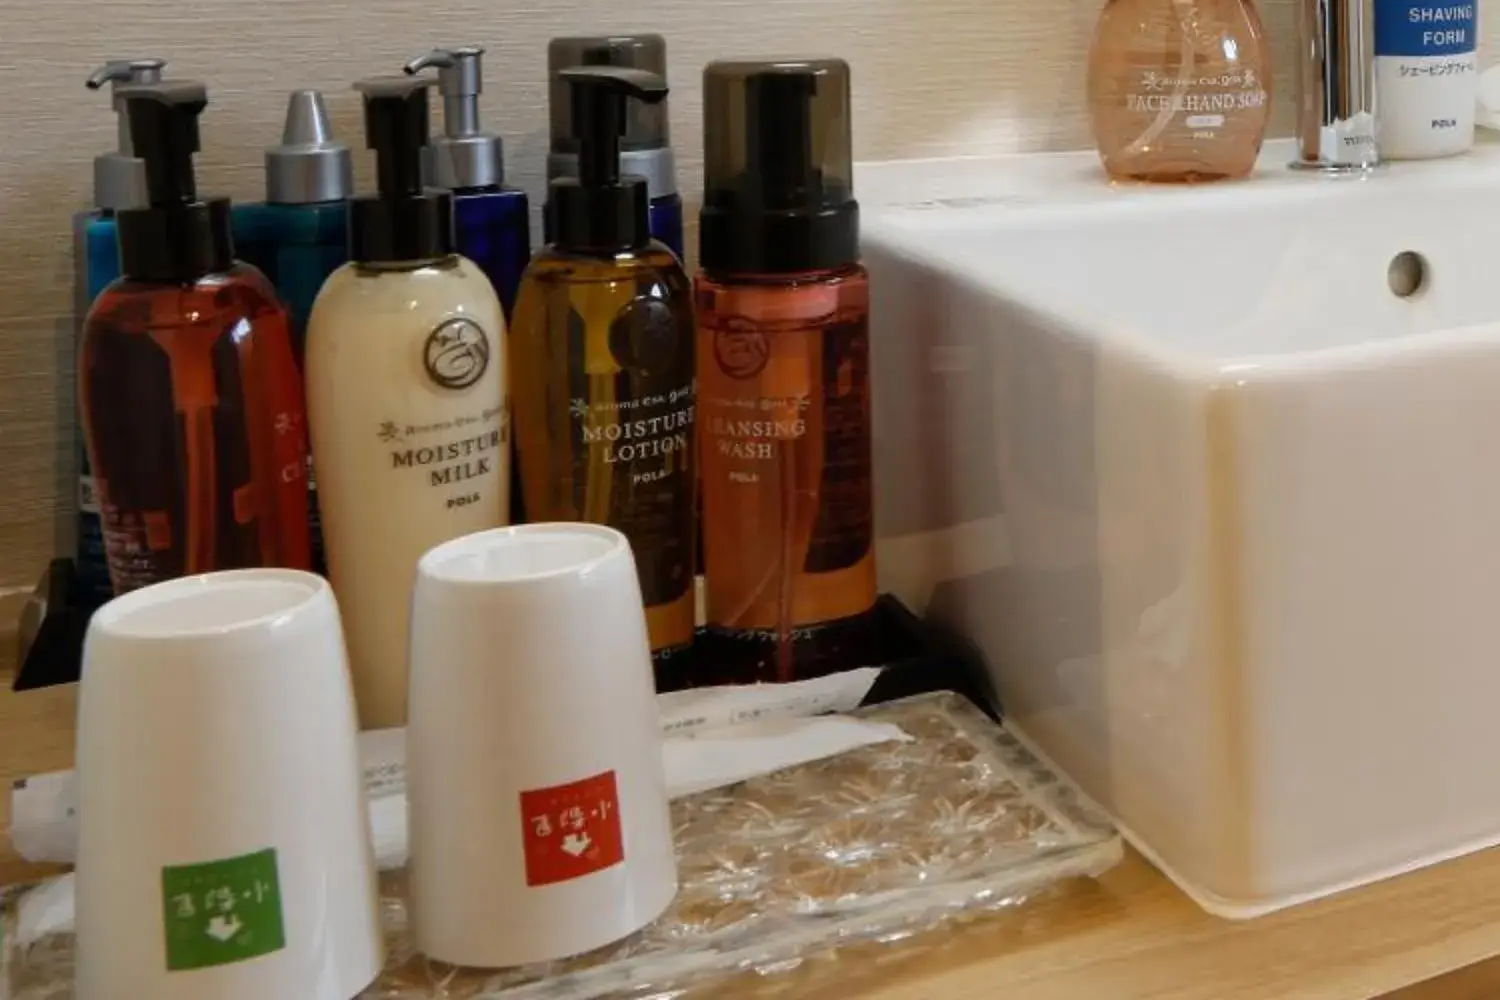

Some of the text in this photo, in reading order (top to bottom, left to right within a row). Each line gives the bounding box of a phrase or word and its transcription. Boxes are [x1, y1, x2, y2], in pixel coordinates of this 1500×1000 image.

[1408, 4, 1473, 23] SHAVING
[1423, 29, 1465, 46] FORM
[1186, 93, 1235, 111] HAND
[603, 433, 688, 464] LOTION
[431, 457, 491, 487] MILK
